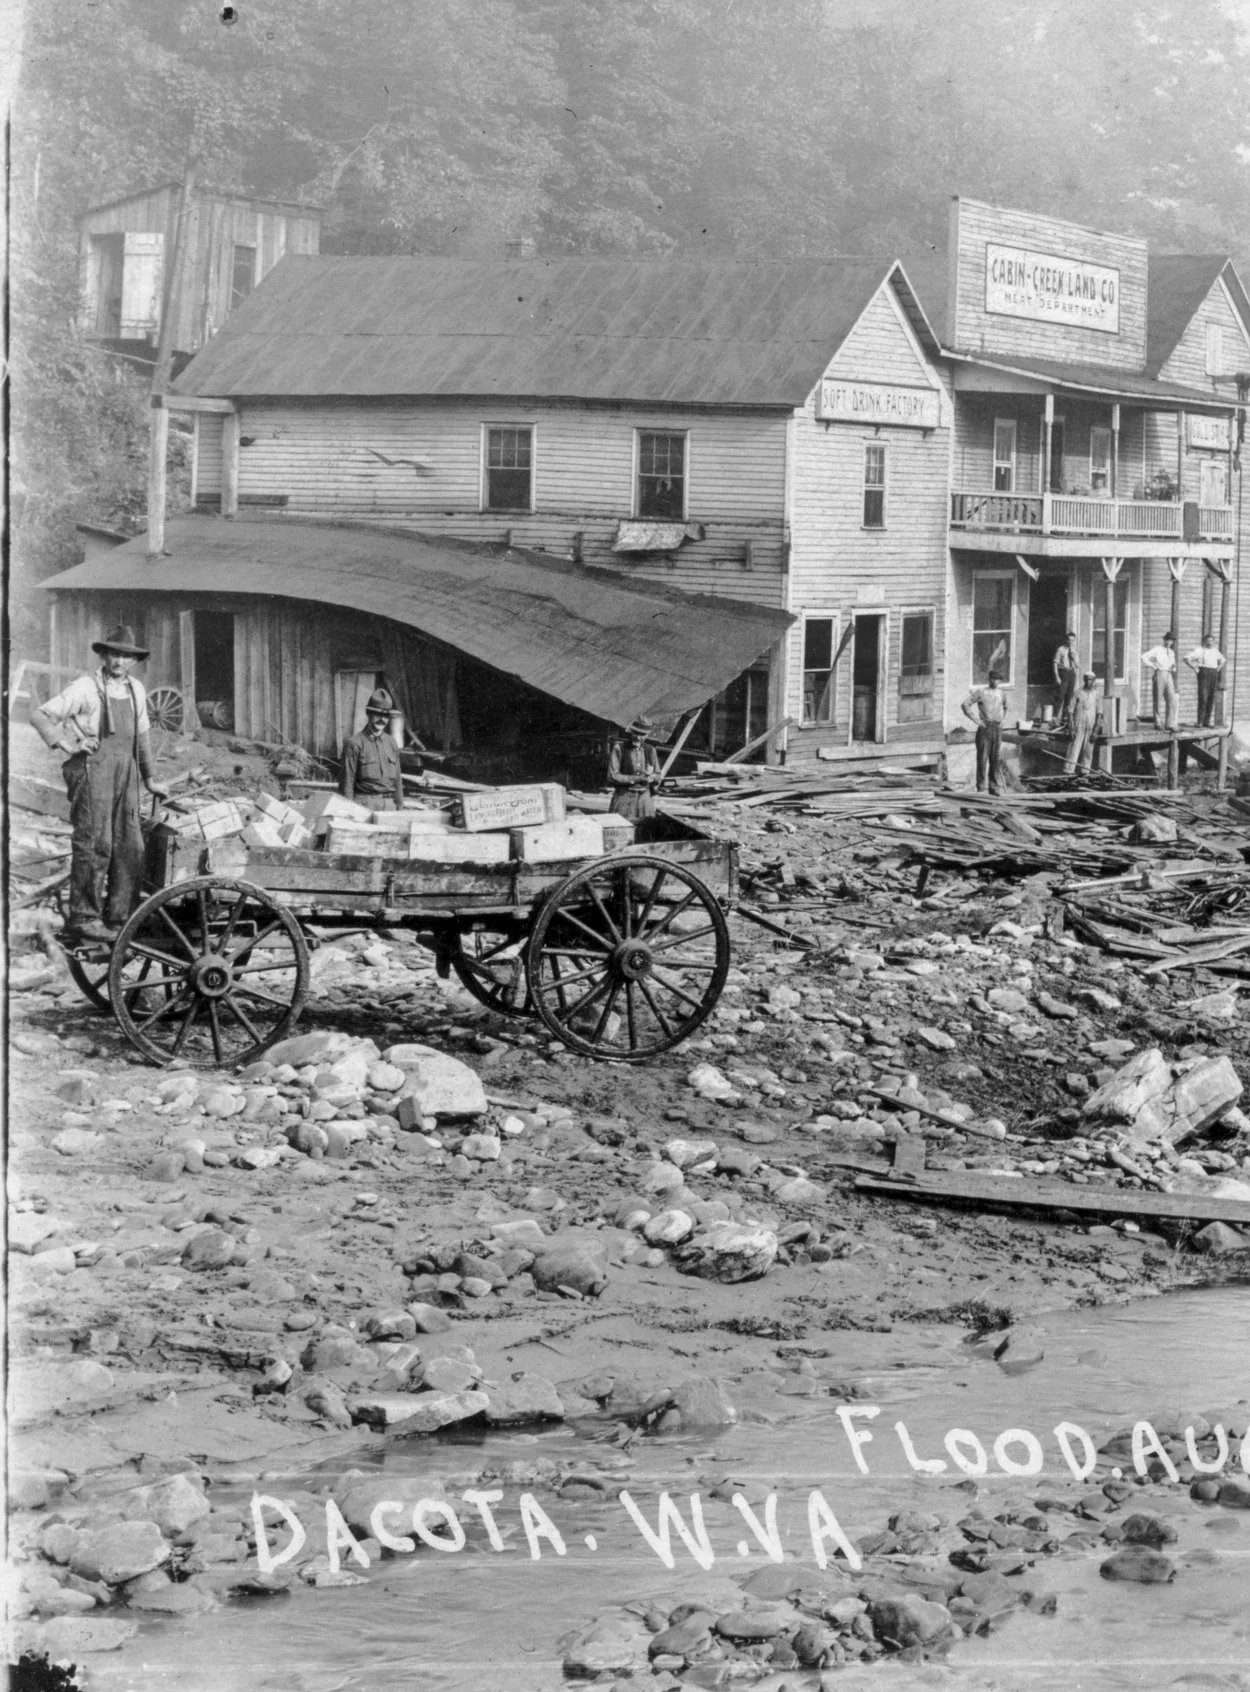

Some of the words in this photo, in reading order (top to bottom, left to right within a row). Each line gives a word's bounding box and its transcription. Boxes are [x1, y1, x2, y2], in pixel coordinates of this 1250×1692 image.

[992, 258, 1064, 296] CABIN-CREEK
[1068, 272, 1096, 300] LAND
[1102, 279, 1115, 304] CO
[1004, 293, 1033, 305] MEAT
[1039, 298, 1105, 318] DEPARTMENT
[823, 387, 847, 409] SOFT
[853, 390, 882, 413] DRINK
[887, 393, 925, 417] FACTORY
